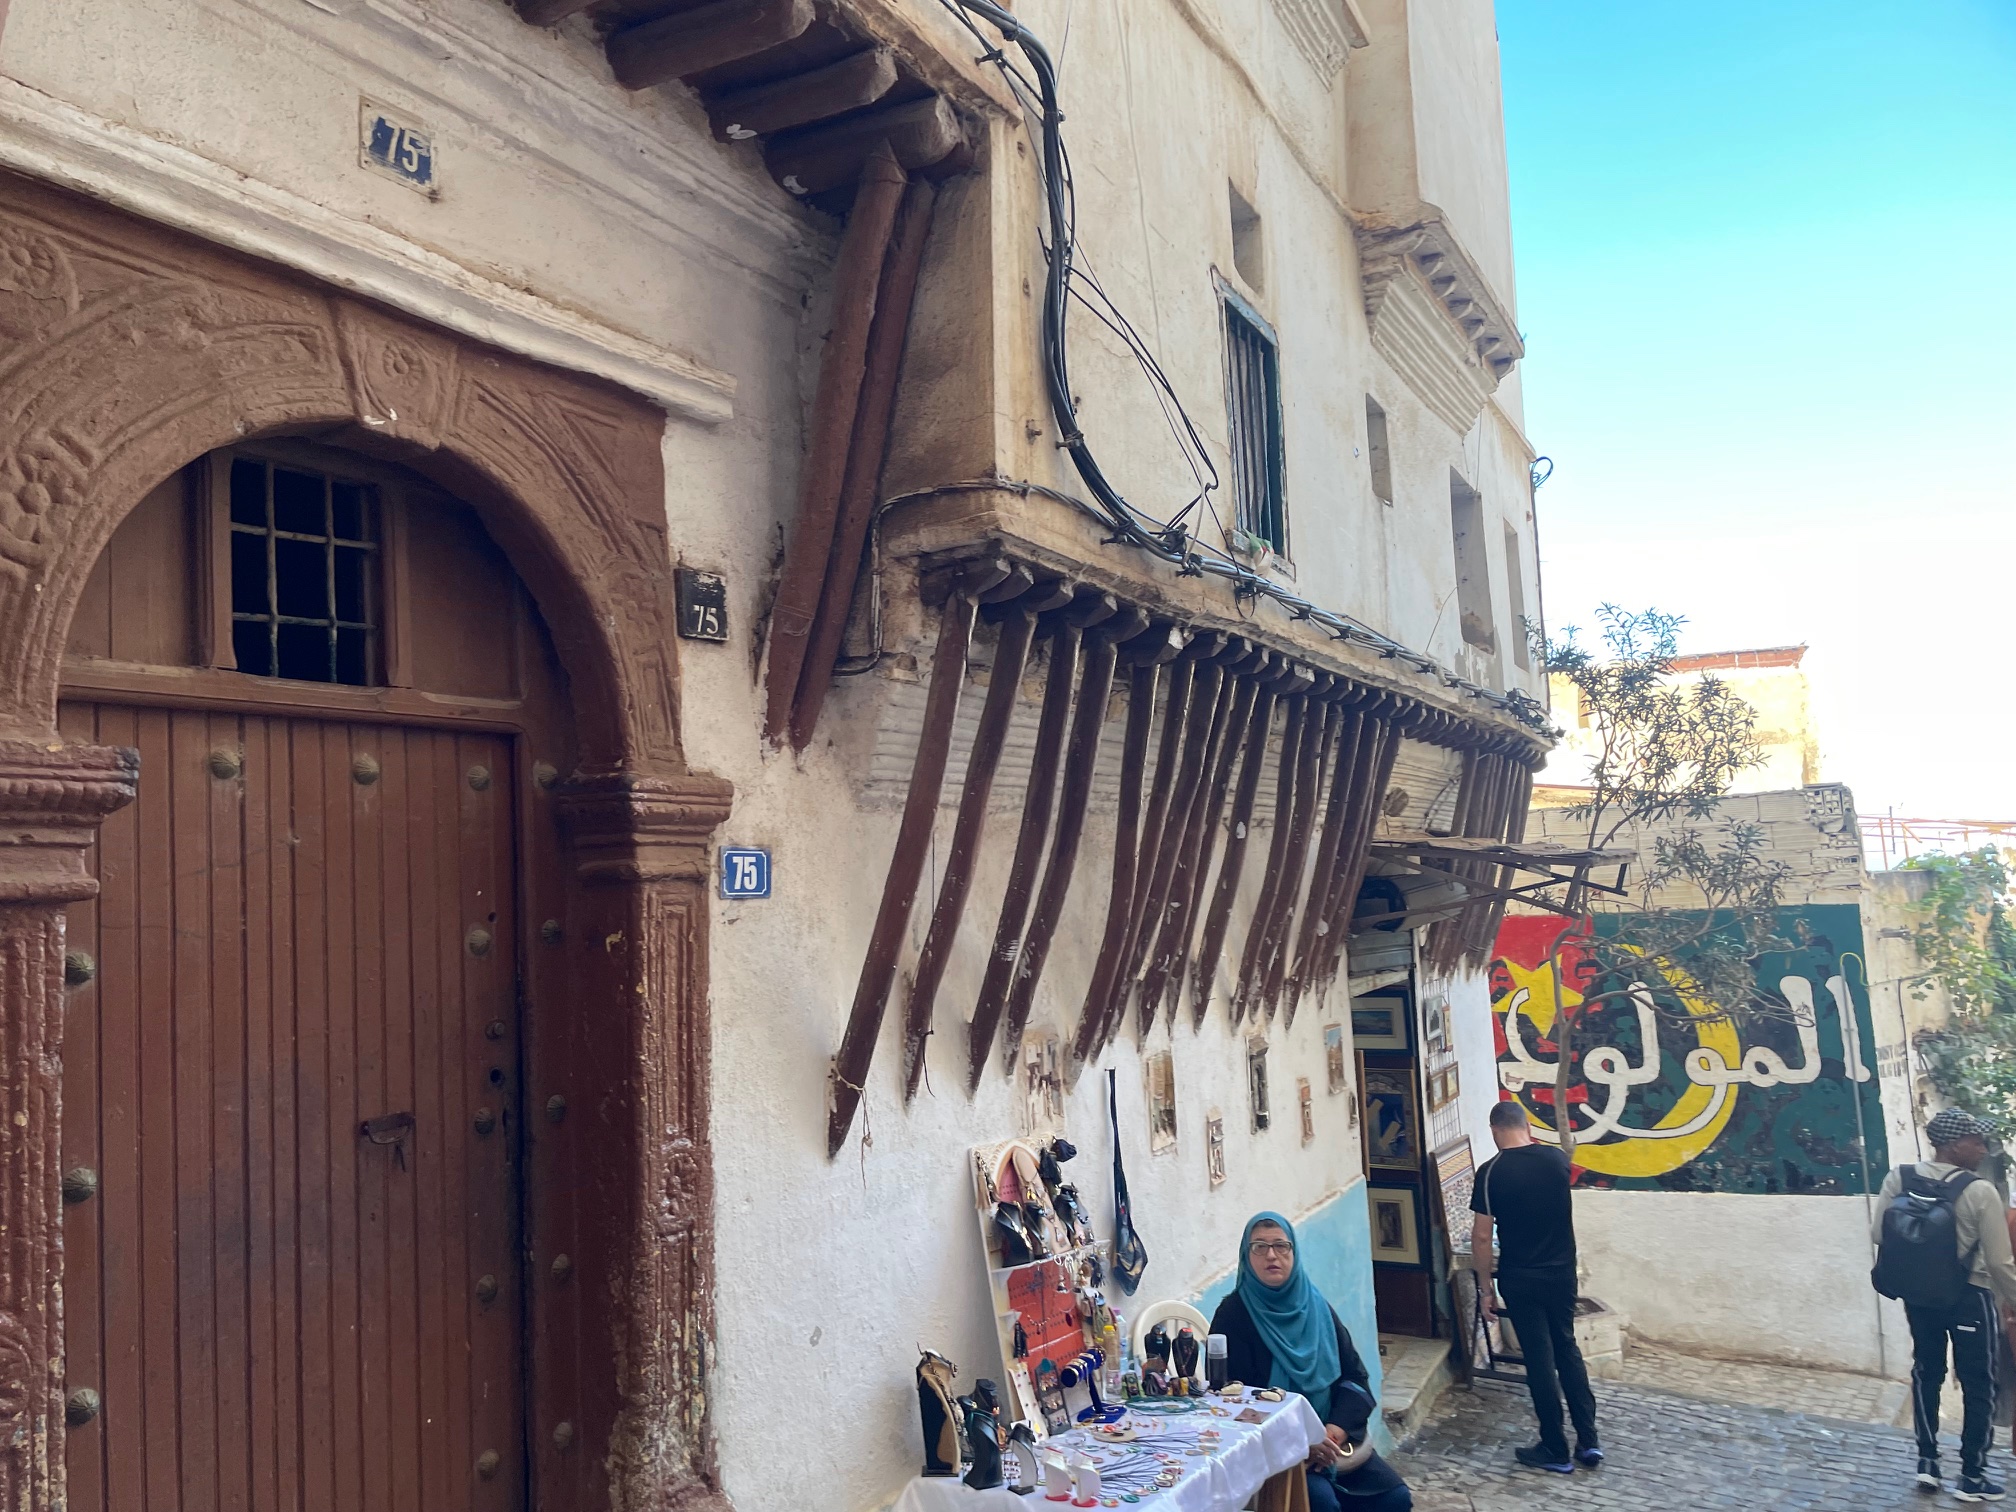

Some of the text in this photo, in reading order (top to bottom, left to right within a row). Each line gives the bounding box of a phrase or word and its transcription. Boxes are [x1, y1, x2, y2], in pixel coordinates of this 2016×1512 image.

[384, 119, 421, 172] 75
[693, 604, 719, 634] 75
[732, 856, 758, 890] 75
